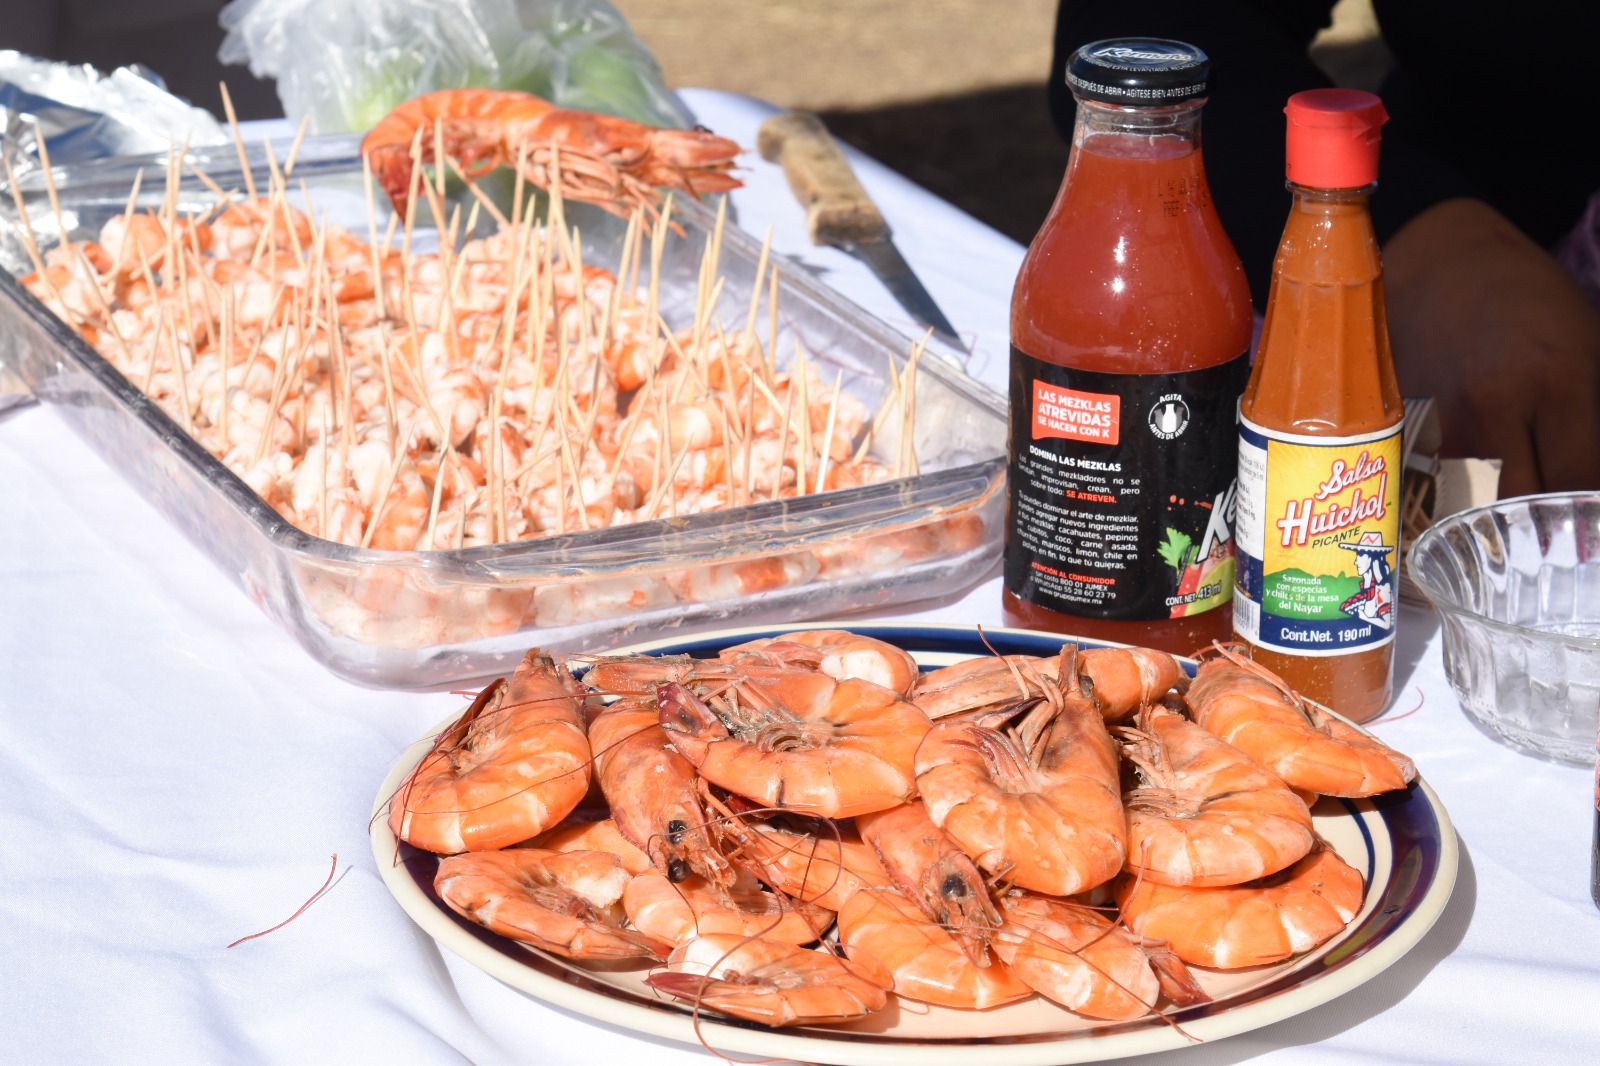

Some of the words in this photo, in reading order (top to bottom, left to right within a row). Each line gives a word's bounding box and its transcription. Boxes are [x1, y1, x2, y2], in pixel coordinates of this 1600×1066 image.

[1077, 78, 1097, 92] DESPUÉS
[1098, 84, 1104, 94] DE
[1104, 86, 1122, 96] ABRIR
[1152, 89, 1166, 98] BIEN
[1166, 87, 1184, 98] ANTES
[1184, 86, 1192, 96] DE
[1038, 388, 1056, 403] LAS
[1058, 394, 1112, 413] MEZKLAS
[1160, 393, 1182, 403] AGITA
[1038, 402, 1112, 427] ATREVIDAS
[1038, 415, 1047, 426] SE
[1048, 418, 1077, 434] HACEN
[1079, 425, 1100, 437] CON
[1102, 429, 1110, 438] K
[1149, 423, 1166, 440] ANTES
[1166, 432, 1174, 440] DE
[1174, 420, 1189, 438] ABRIR
[1030, 445, 1057, 462] DOMINA
[1059, 455, 1075, 467] LAS
[1076, 458, 1122, 472] MEZKLAS
[1030, 460, 1054, 475] grandes
[1058, 470, 1106, 484] mezkladores
[1314, 450, 1385, 501] Salsa
[1030, 480, 1046, 490] sobre
[1047, 484, 1064, 496] todo:
[1066, 490, 1076, 498] SE
[1078, 492, 1117, 503] ATREVEN.
[1120, 487, 1140, 495] pero
[1042, 501, 1069, 516] dominar
[1070, 509, 1077, 517] el
[1078, 511, 1093, 521] arte
[1094, 513, 1105, 521] de
[1276, 471, 1388, 549] Huichol
[1030, 516, 1056, 530] mezklas:
[1058, 526, 1102, 540] cacahuates,
[1105, 532, 1138, 542] pepinos
[1036, 508, 1059, 522] agregar
[1060, 518, 1086, 528] nuevos
[1088, 521, 1139, 533] ingredientes
[1055, 534, 1073, 545] coco,
[1080, 540, 1103, 549] carne
[1111, 543, 1138, 551] asada,
[1312, 526, 1361, 548] PICANTE
[1039, 548, 1047, 556] en
[1047, 550, 1057, 559] fin,
[1059, 554, 1066, 562] lo
[1068, 556, 1082, 566] que
[1084, 558, 1092, 566] tú
[1094, 560, 1126, 570] quieras.
[1041, 540, 1072, 554] mariscos,
[1075, 548, 1099, 559] limón,
[1103, 551, 1123, 560] chile
[1032, 561, 1058, 576] ATENCIÓN
[1068, 573, 1116, 586] CONSUMIDOR
[1044, 573, 1059, 583] costo
[1060, 578, 1073, 587] 800
[1085, 583, 1108, 591] JUMEX
[1282, 574, 1321, 585] Sazonada
[1034, 577, 1063, 592] WhatsApp
[1063, 586, 1072, 594] 55
[1073, 587, 1082, 595] 28
[1038, 586, 1103, 605] www.grupojumex.mx
[1165, 596, 1183, 606] CONT.
[1197, 586, 1212, 600] 413
[1212, 581, 1222, 596] ml
[1266, 588, 1270, 596] y
[1272, 589, 1293, 600] chiles
[1295, 592, 1306, 601] de
[1308, 593, 1316, 602] la
[1276, 582, 1290, 590] con
[1291, 584, 1327, 595] especias
[1279, 600, 1291, 609] del
[1293, 604, 1323, 614] Nayar
[1338, 630, 1358, 642] 190
[1359, 625, 1372, 638] ml
